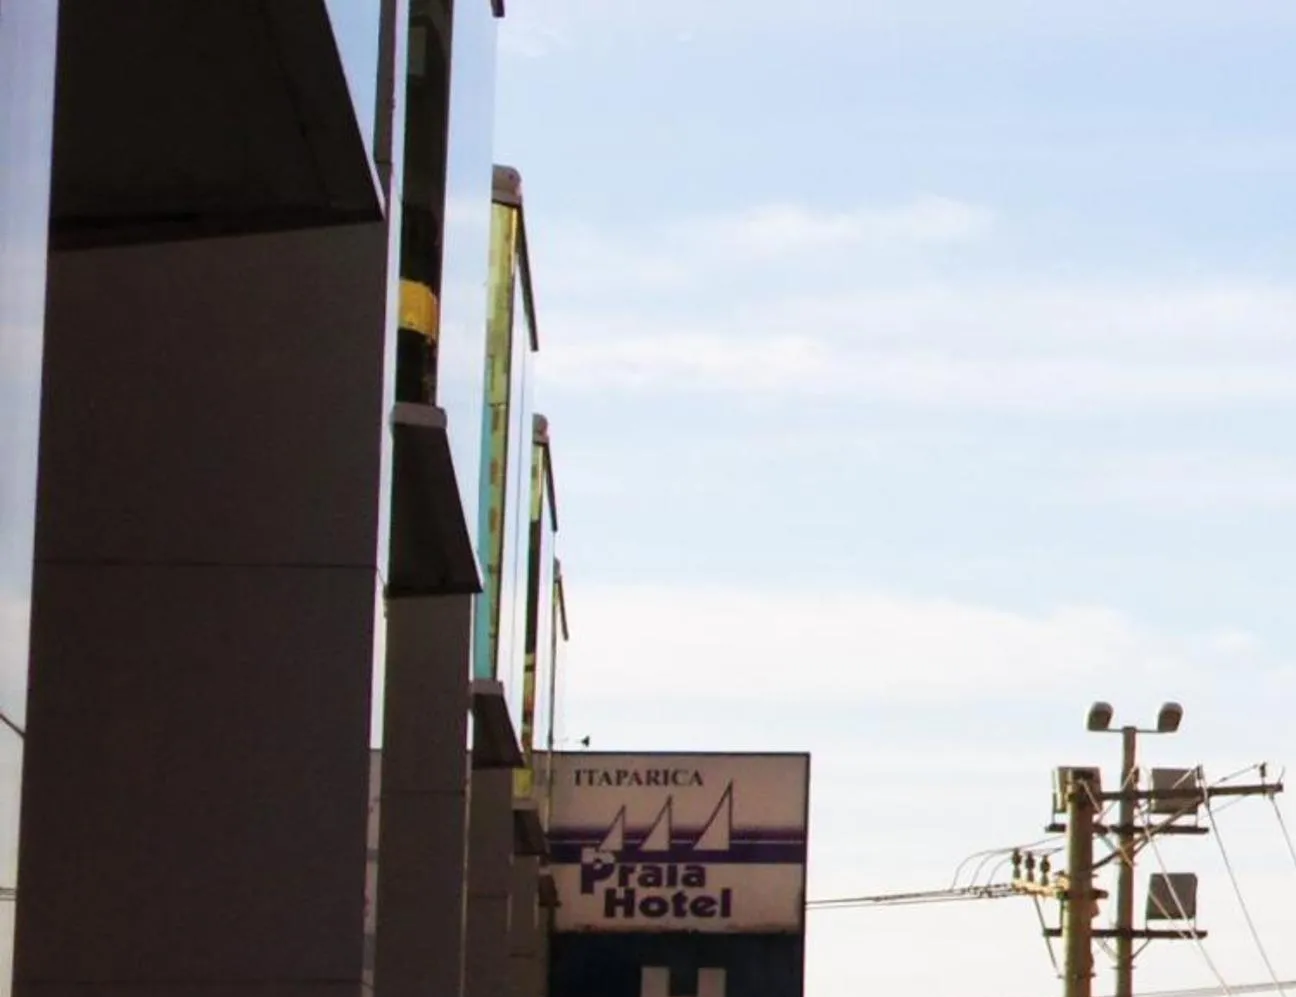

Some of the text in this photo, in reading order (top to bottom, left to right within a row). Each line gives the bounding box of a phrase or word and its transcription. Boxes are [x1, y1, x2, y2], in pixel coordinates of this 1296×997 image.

[574, 768, 704, 787] ITAPARICA
[580, 846, 706, 894] Praia
[603, 887, 732, 918] Hotel
